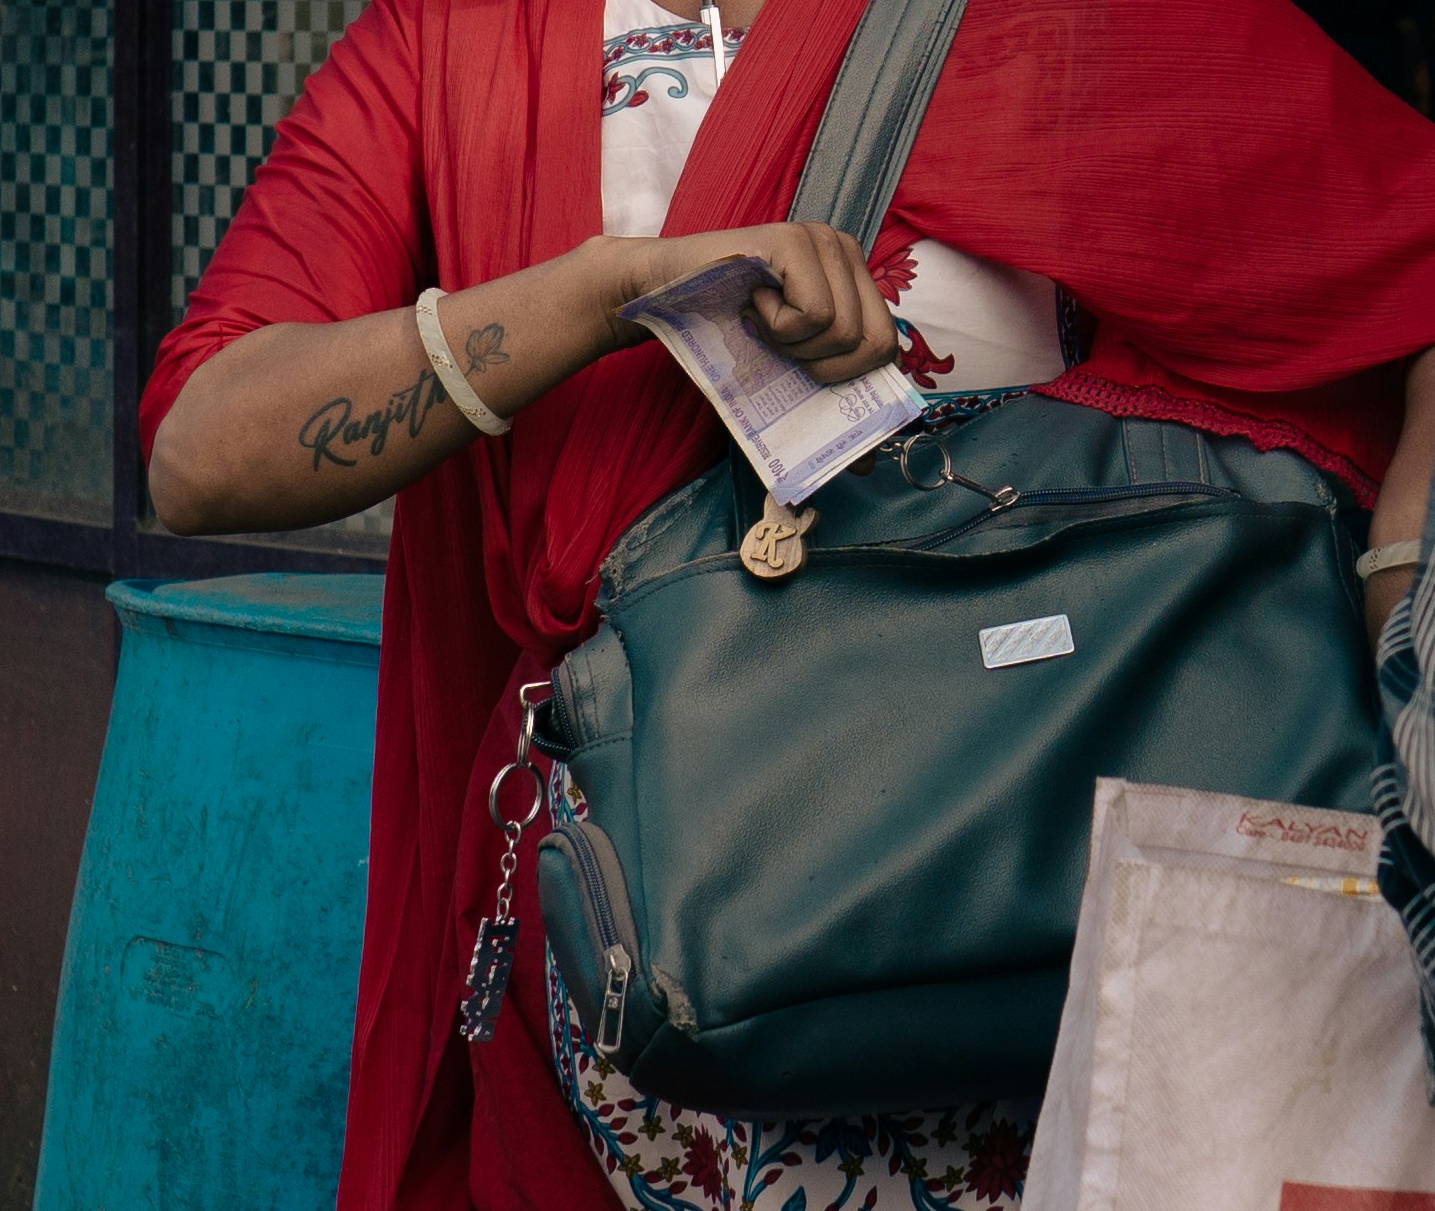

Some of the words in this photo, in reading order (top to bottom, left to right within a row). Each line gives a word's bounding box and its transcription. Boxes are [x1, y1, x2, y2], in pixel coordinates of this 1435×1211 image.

[680, 330, 711, 367] HUNDRED
[703, 363, 722, 384] ONE
[719, 386, 739, 408] INDIA
[732, 405, 745, 419] OF
[740, 416, 759, 440] BANK
[752, 434, 772, 460] RESERVE
[1237, 813, 1368, 840] KALYAN
